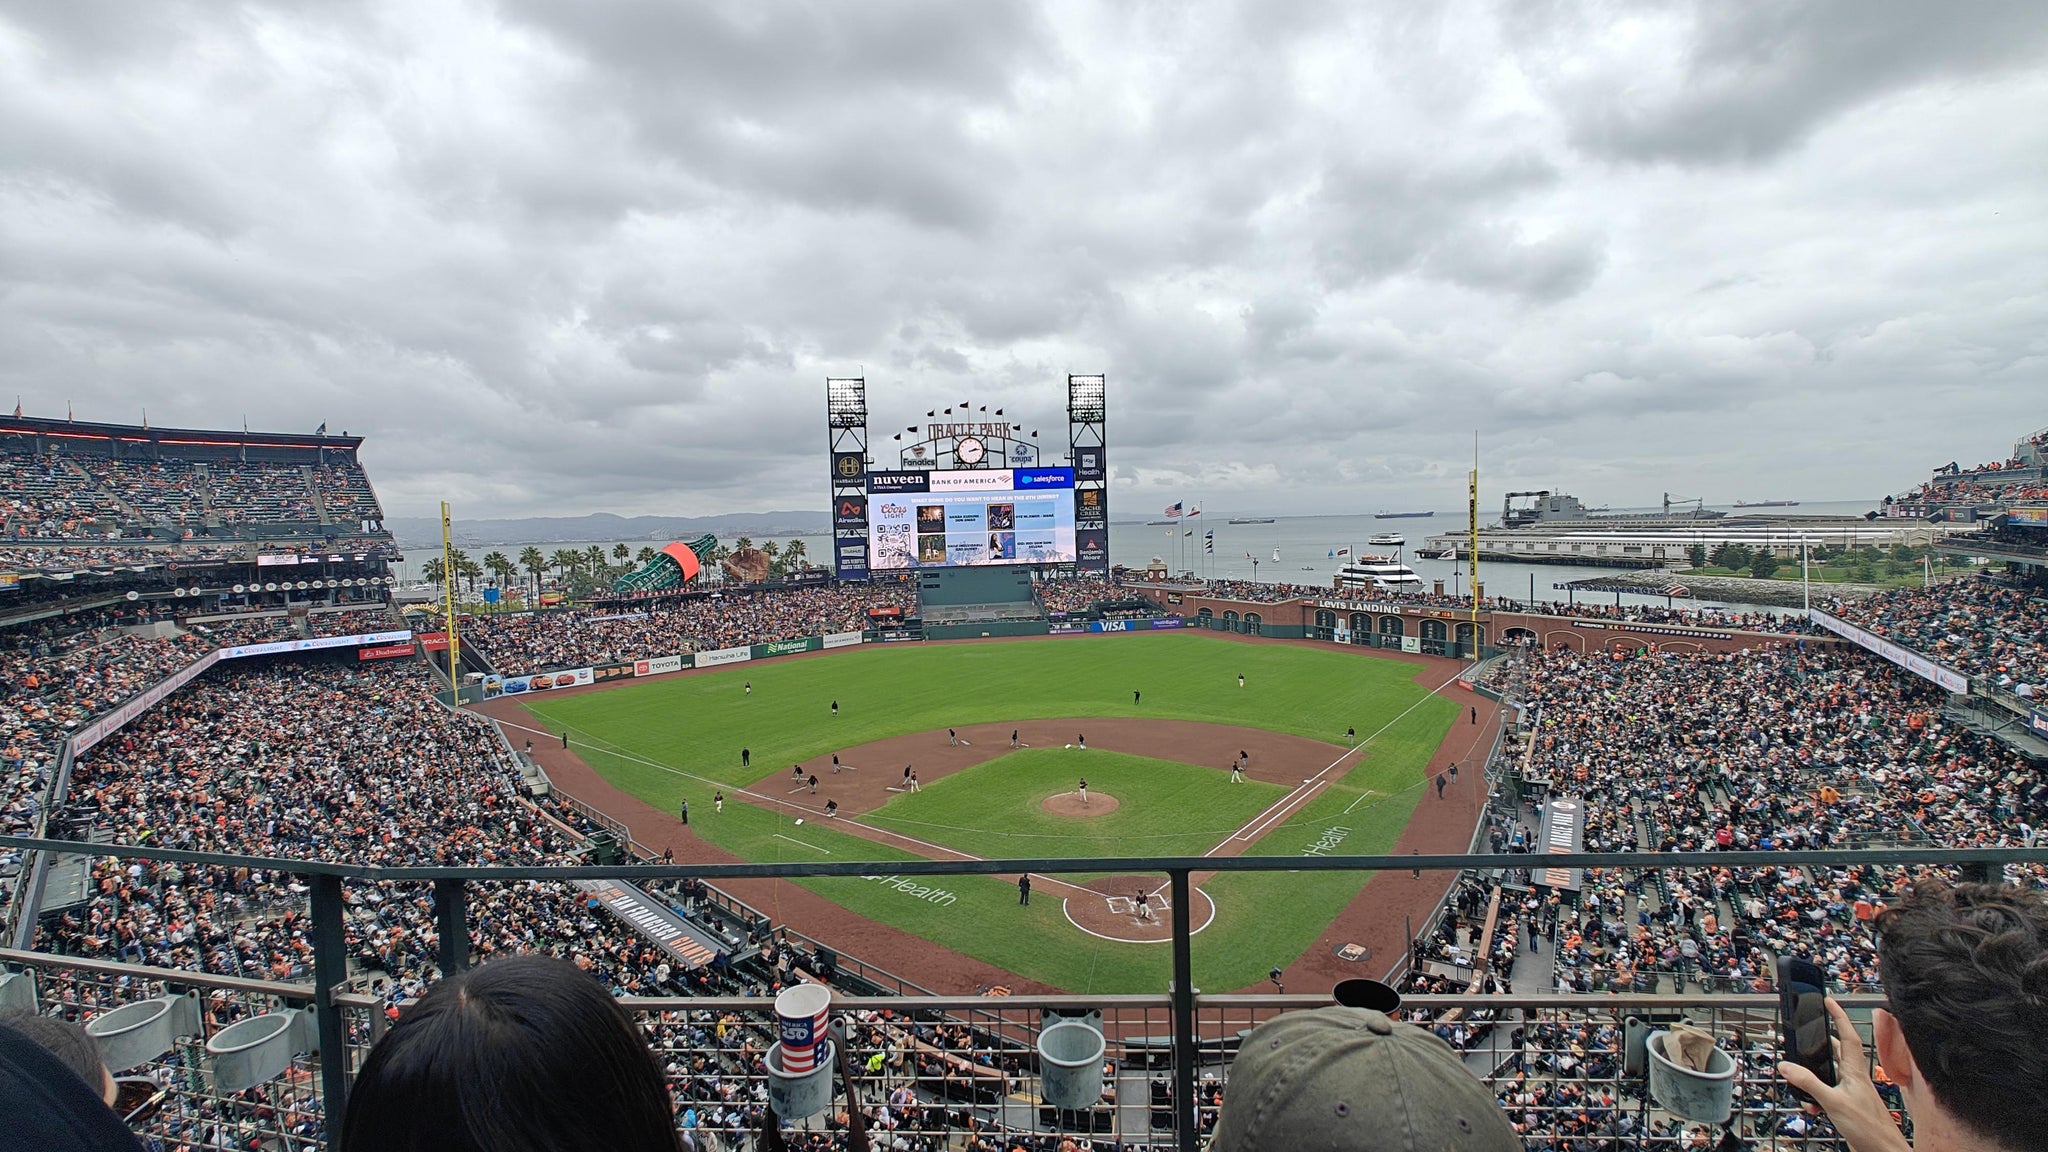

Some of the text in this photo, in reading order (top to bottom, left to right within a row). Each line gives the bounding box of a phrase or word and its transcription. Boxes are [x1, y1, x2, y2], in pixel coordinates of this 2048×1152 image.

[928, 422, 1011, 439] ORACLE PARK
[903, 458, 935, 466] Fanatics
[873, 476, 924, 484] nuveen
[1034, 475, 1064, 483] salesforce
[881, 503, 907, 513] Coors
[1553, 583, 1586, 591] BANK
[1601, 585, 1657, 595] AMERICA
[1350, 603, 1401, 614] LANDING
[1101, 622, 1126, 631] VISA
[777, 640, 807, 651] National
[376, 647, 411, 656] Budweiser
[652, 660, 679, 669] TOYOTA
[1301, 826, 1352, 856] Health
[880, 875, 957, 907] Health
[609, 895, 716, 964] SAN FRANCISCO GIANTS
